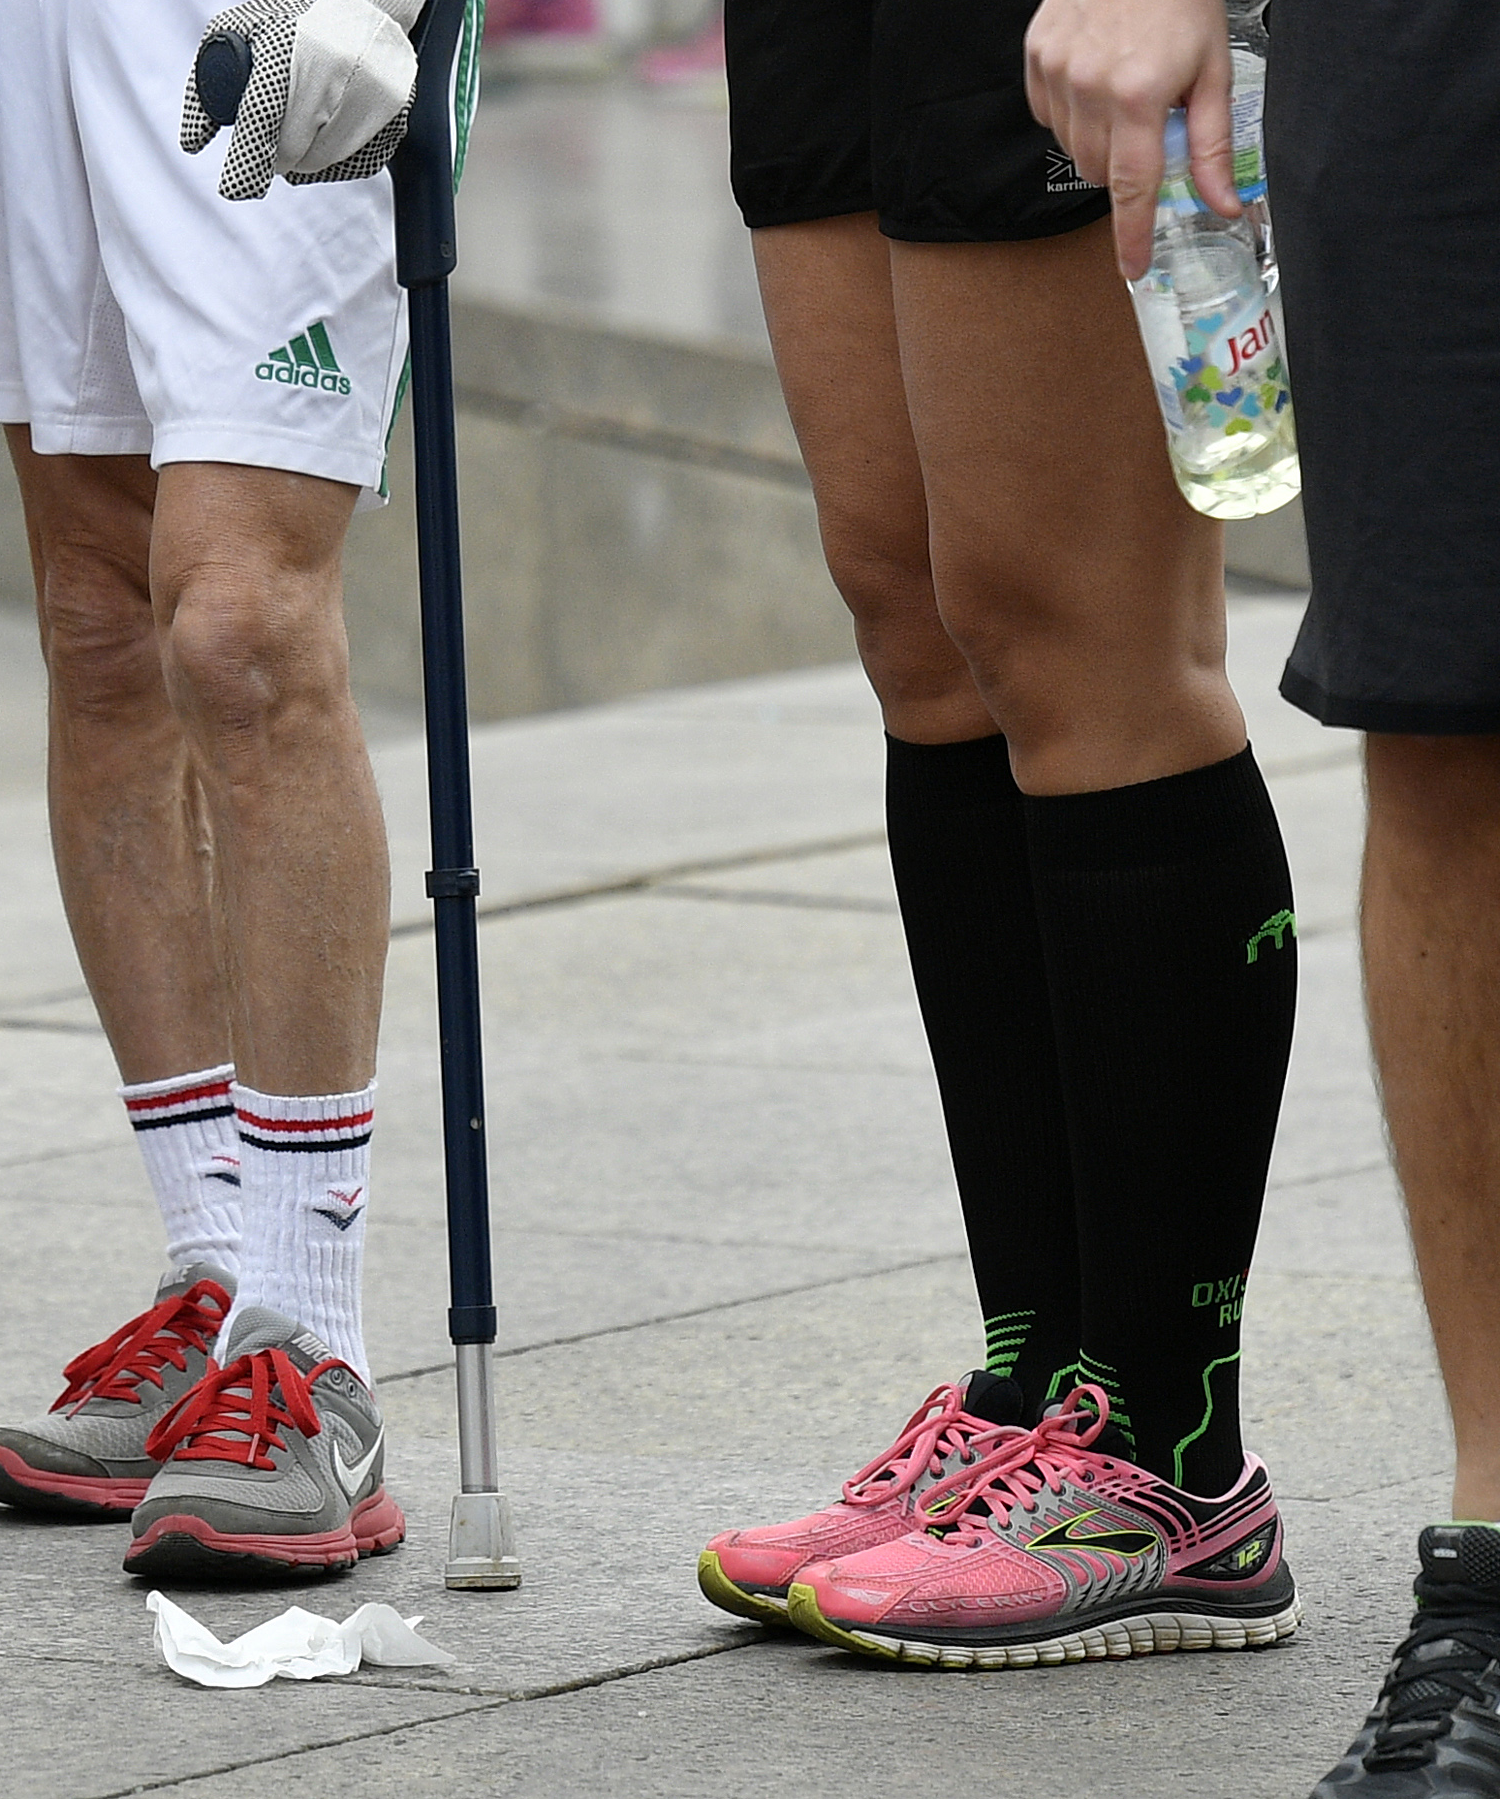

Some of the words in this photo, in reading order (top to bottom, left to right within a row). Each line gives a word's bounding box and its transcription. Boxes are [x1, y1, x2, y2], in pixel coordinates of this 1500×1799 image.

[1047, 179, 1104, 193] karrim
[255, 362, 352, 396] adidas
[1236, 1540, 1263, 1569] 12
